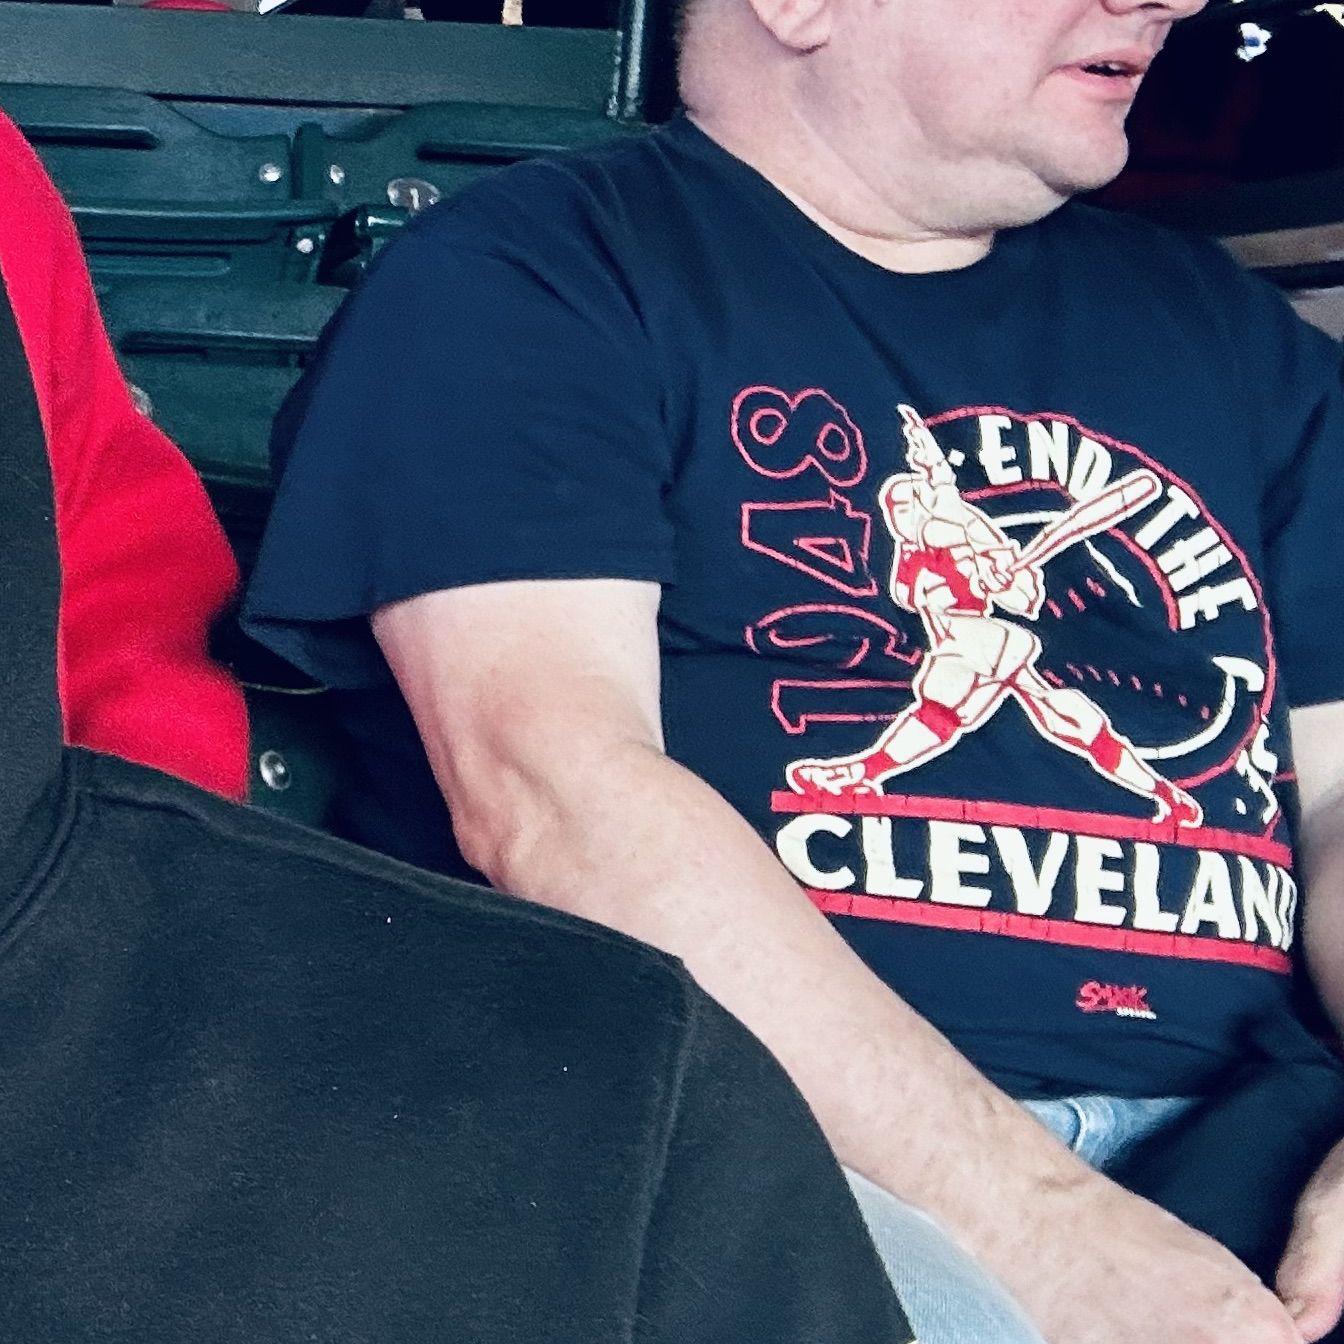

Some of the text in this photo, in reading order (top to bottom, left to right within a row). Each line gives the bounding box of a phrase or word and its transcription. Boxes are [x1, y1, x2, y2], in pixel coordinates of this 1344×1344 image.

[731, 384, 922, 736] 1948
[977, 414, 1260, 631] END THE
